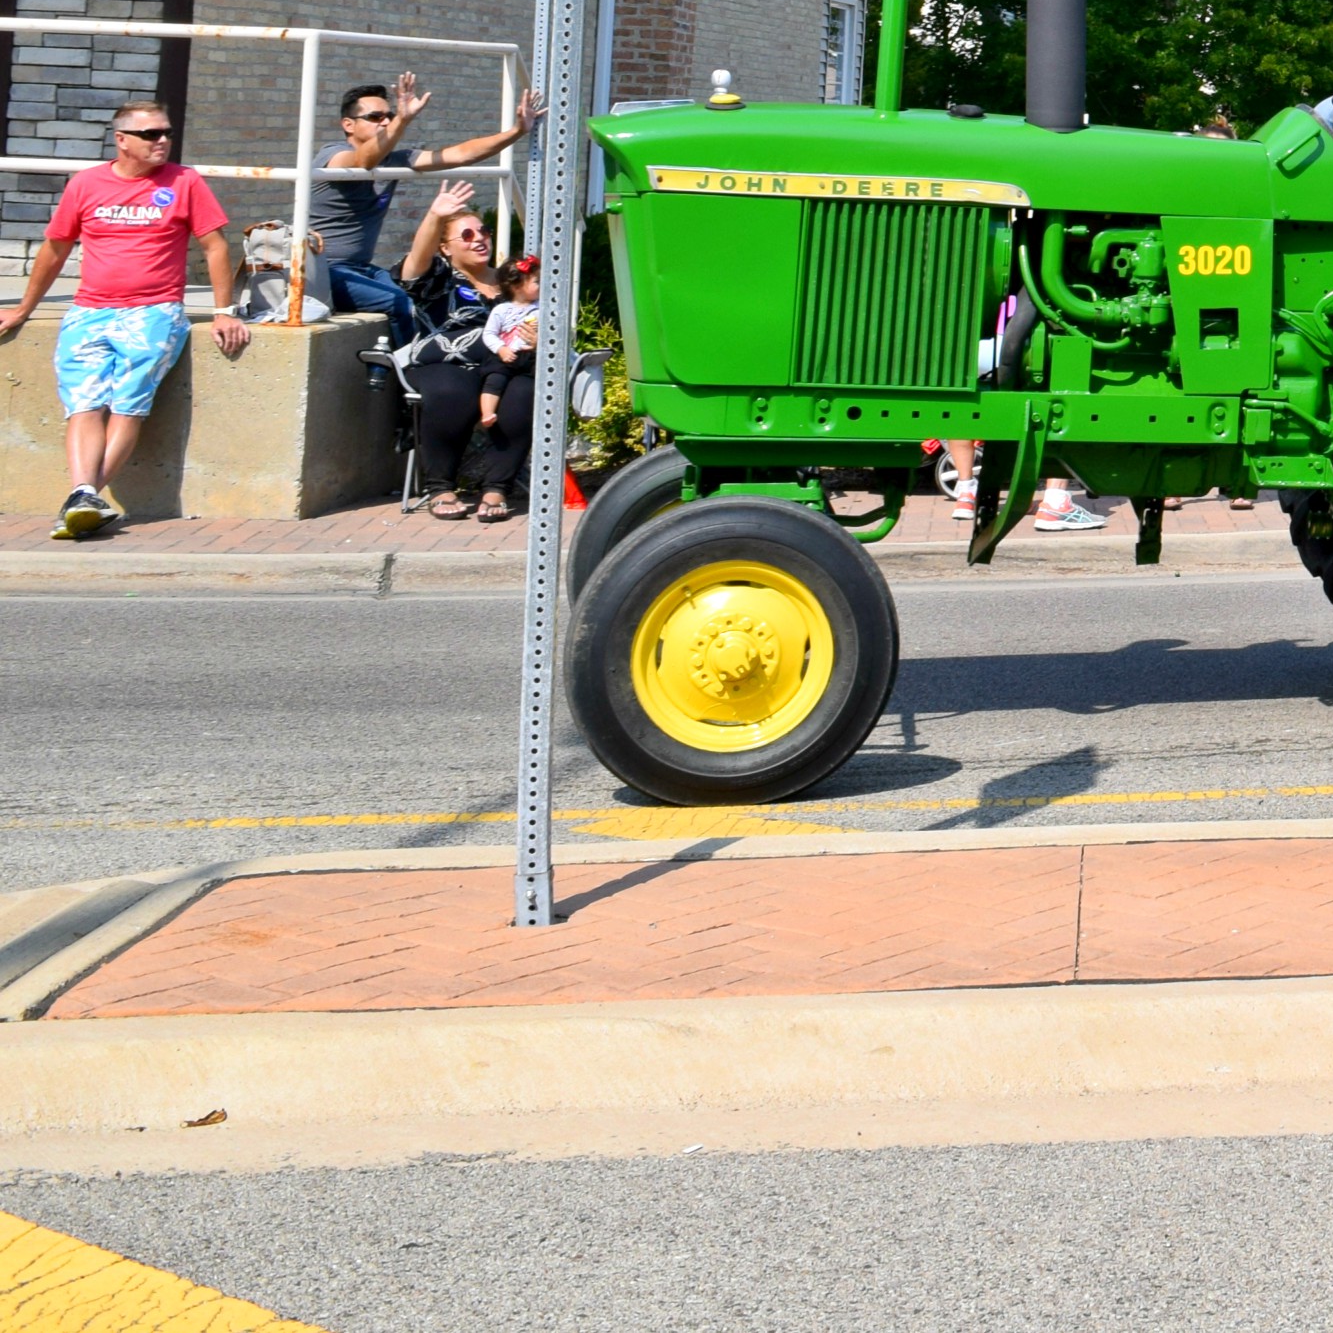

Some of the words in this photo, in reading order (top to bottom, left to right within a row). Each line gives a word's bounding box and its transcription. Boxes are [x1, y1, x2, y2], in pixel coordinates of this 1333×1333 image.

[696, 174, 787, 193] JOHN
[831, 179, 944, 198] DEERE
[94, 205, 162, 220] CATALINA
[1178, 245, 1251, 275] 3020
